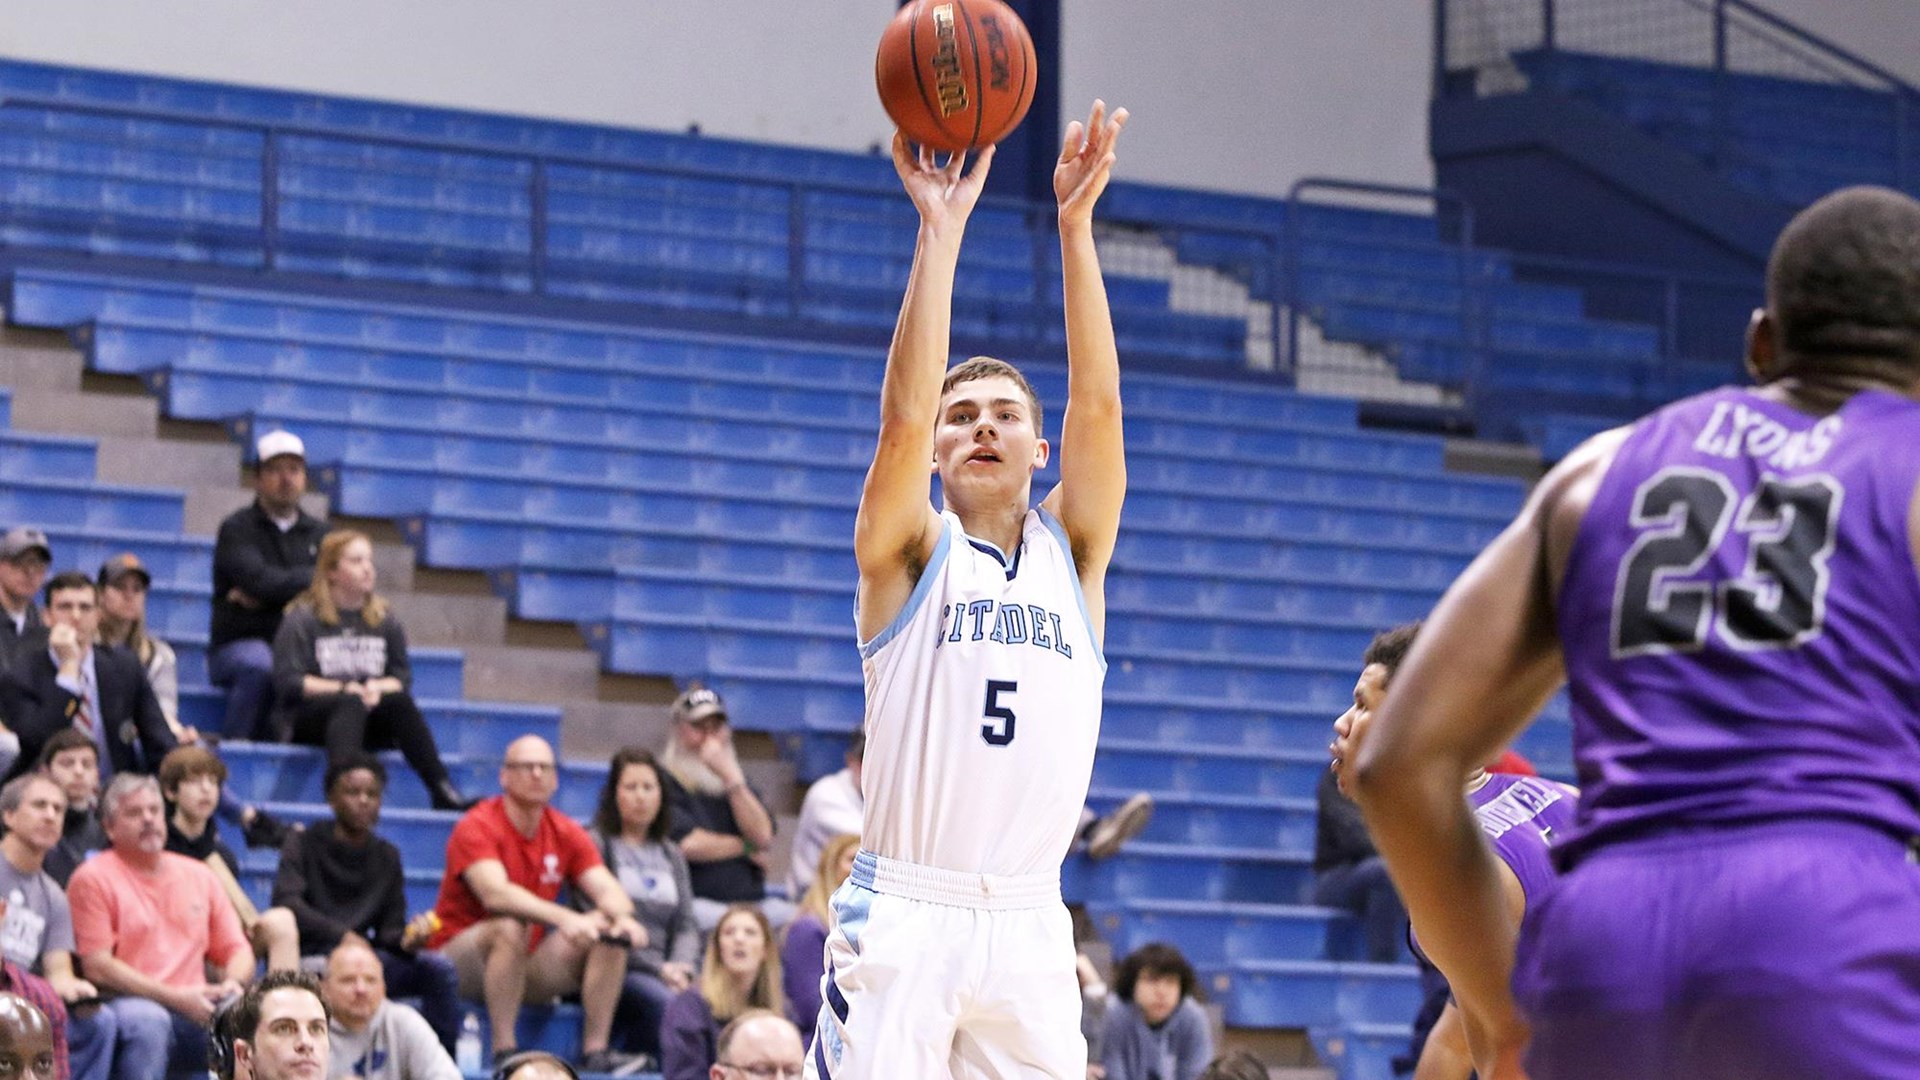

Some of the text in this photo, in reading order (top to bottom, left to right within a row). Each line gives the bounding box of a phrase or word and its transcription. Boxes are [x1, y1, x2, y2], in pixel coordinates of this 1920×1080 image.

[1694, 401, 1843, 468] LYONS
[1611, 465, 1844, 659] 23
[980, 678, 1018, 747] 5
